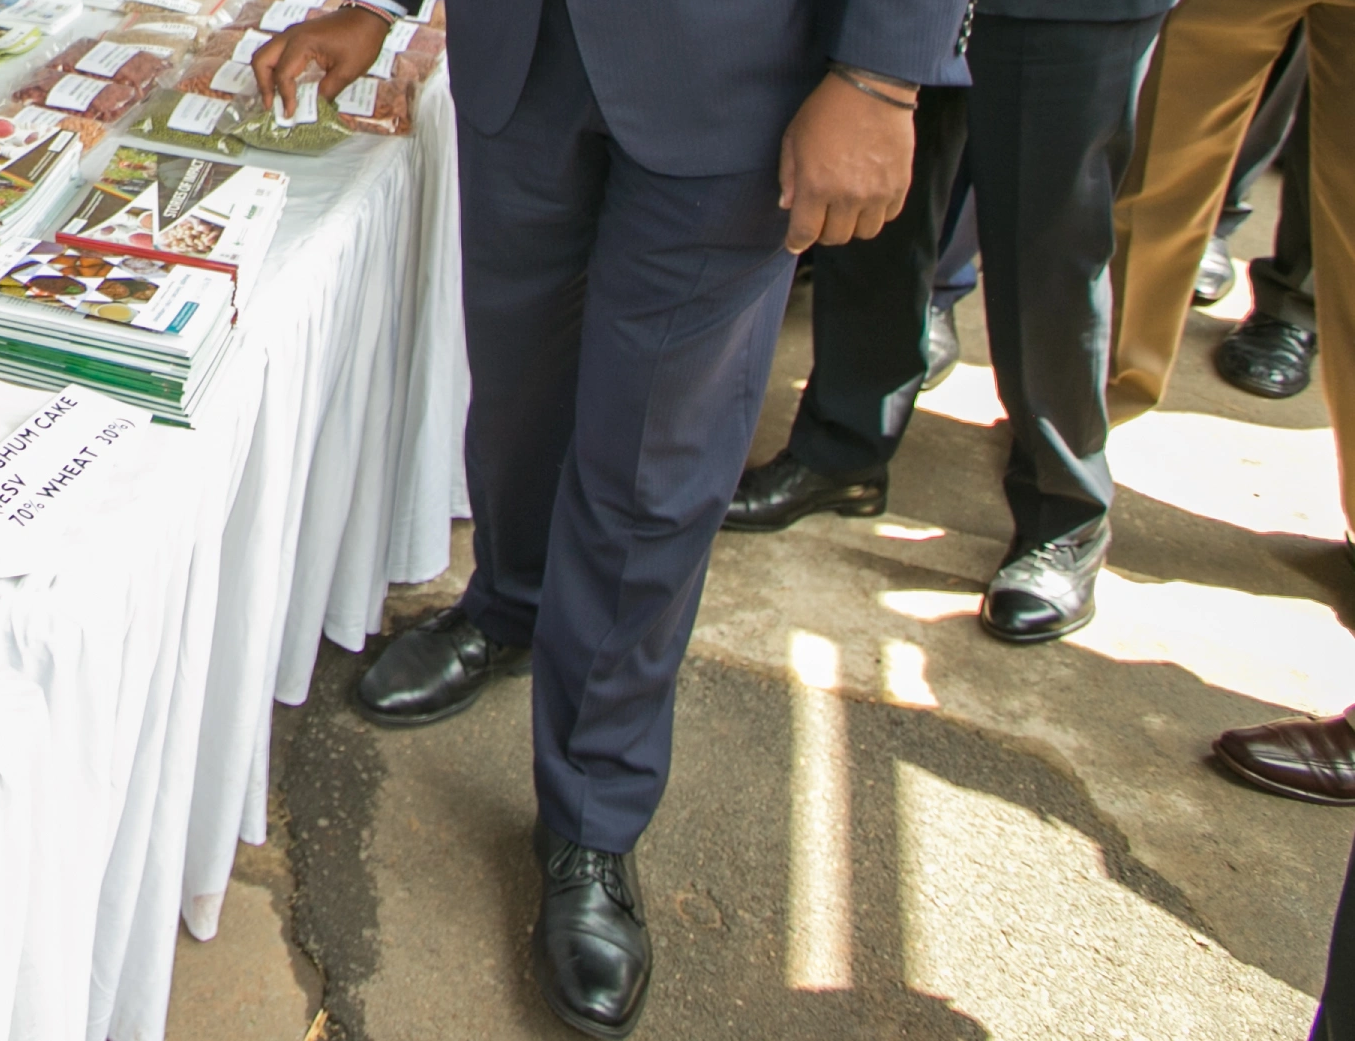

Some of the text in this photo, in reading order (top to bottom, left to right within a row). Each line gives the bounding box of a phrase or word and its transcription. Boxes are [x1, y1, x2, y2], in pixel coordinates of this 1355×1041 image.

[164, 191, 186, 218] STORIES
[185, 159, 204, 182] IMPACT
[35, 396, 78, 429] CAKE
[8, 418, 136, 526] 70% WHEAT 30%)
